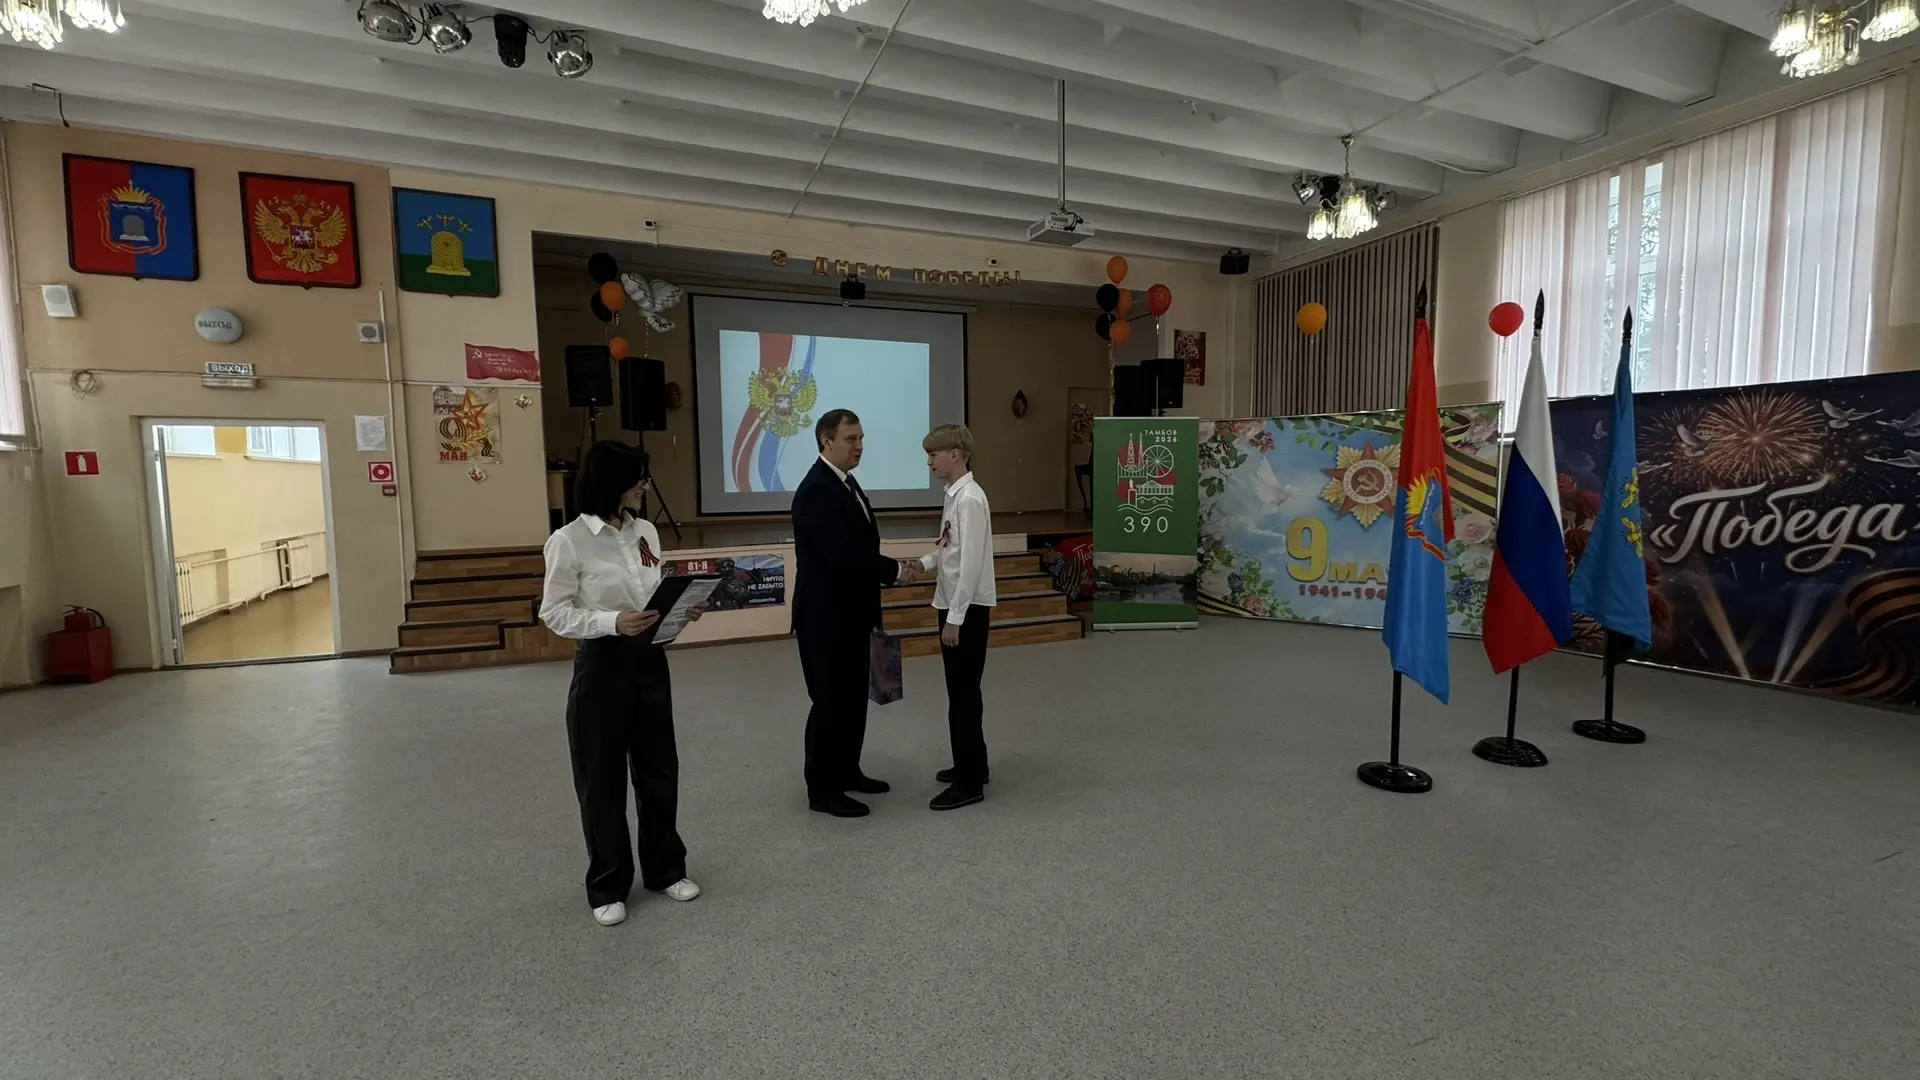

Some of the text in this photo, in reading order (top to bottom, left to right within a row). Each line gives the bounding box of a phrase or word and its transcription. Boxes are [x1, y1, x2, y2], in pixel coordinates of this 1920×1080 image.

[813, 257, 891, 280] ДНЕМ
[913, 268, 1021, 288] ПОБЕДЫ!
[211, 364, 249, 374] ВЫХОД
[440, 451, 468, 461] МАЯ
[1123, 516, 1169, 533] 390
[1650, 480, 1920, 573] «Победа
[1286, 516, 1389, 585] 9 МА
[1298, 584, 1387, 600] 1941-194
